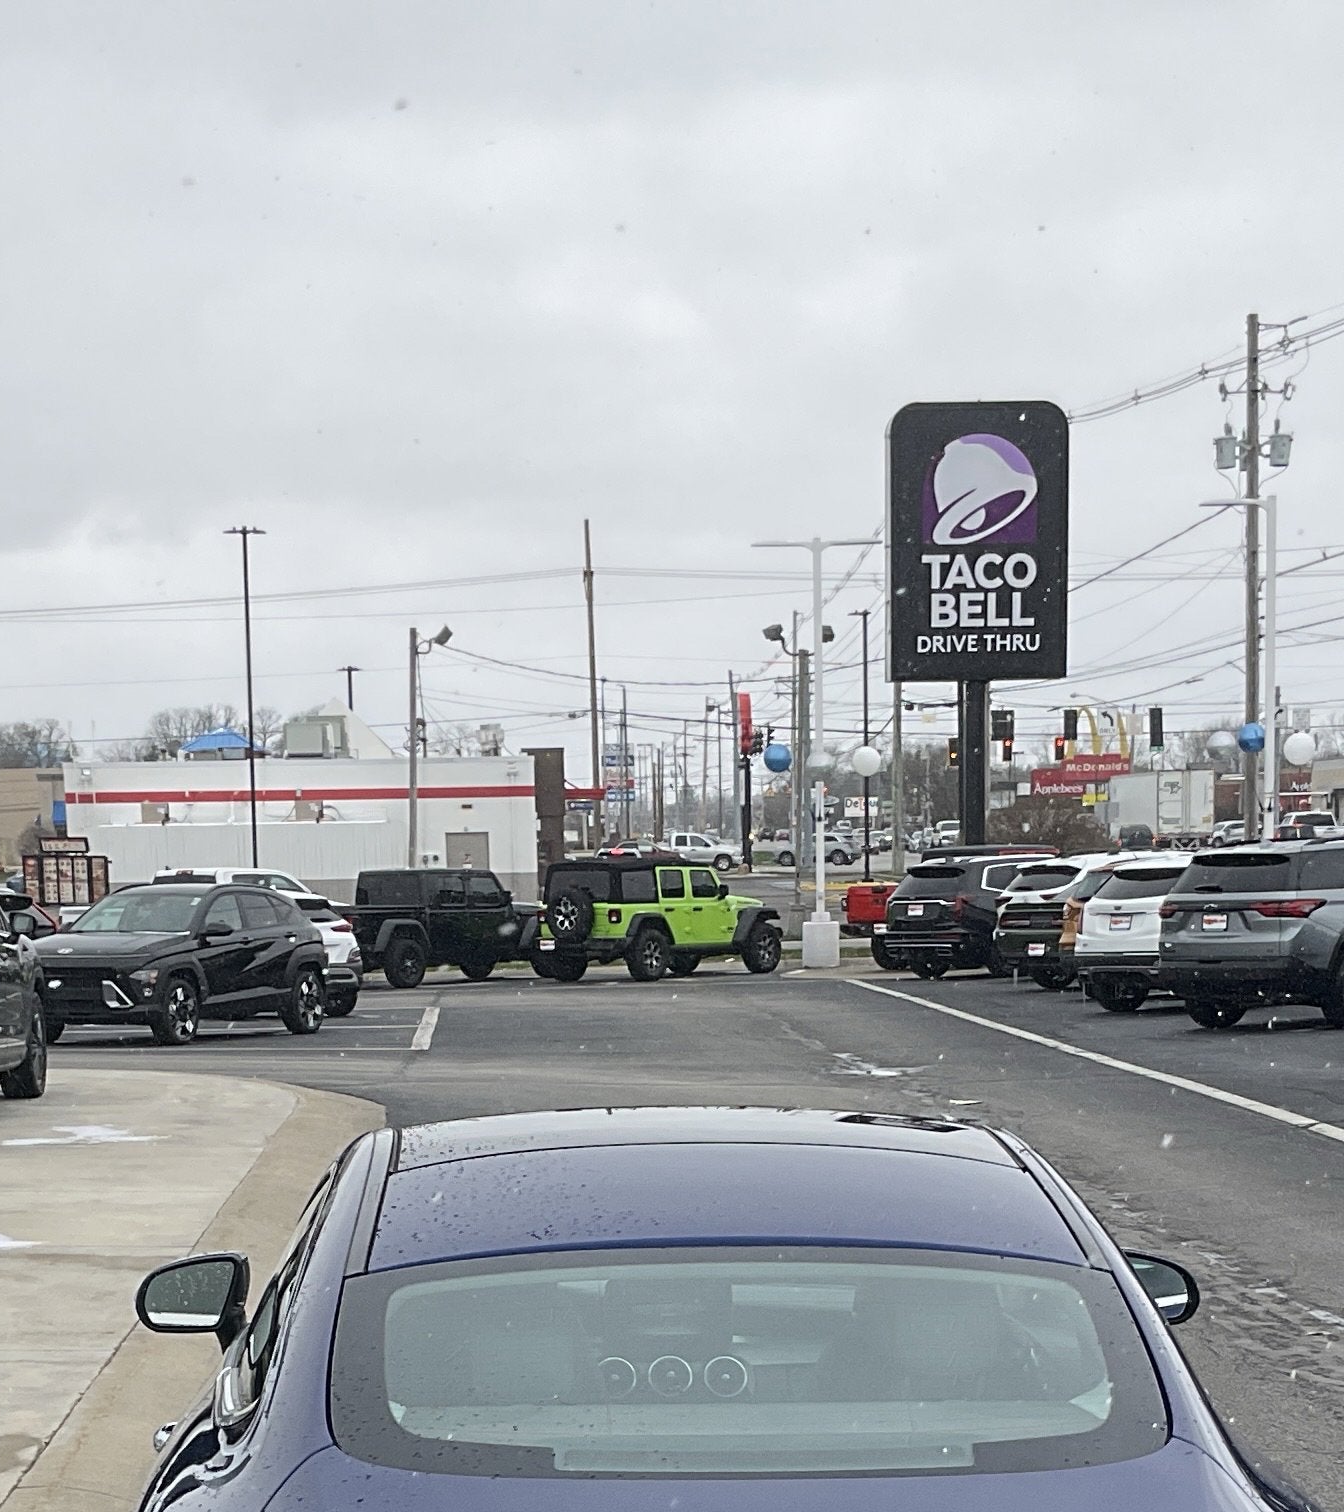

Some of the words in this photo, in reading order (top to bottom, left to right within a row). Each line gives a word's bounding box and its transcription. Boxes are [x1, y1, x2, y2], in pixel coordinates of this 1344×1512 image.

[921, 553, 1037, 589] TACO
[931, 592, 1035, 627] BELL
[917, 634, 978, 653] DRIVE
[983, 633, 1041, 652] THRU
